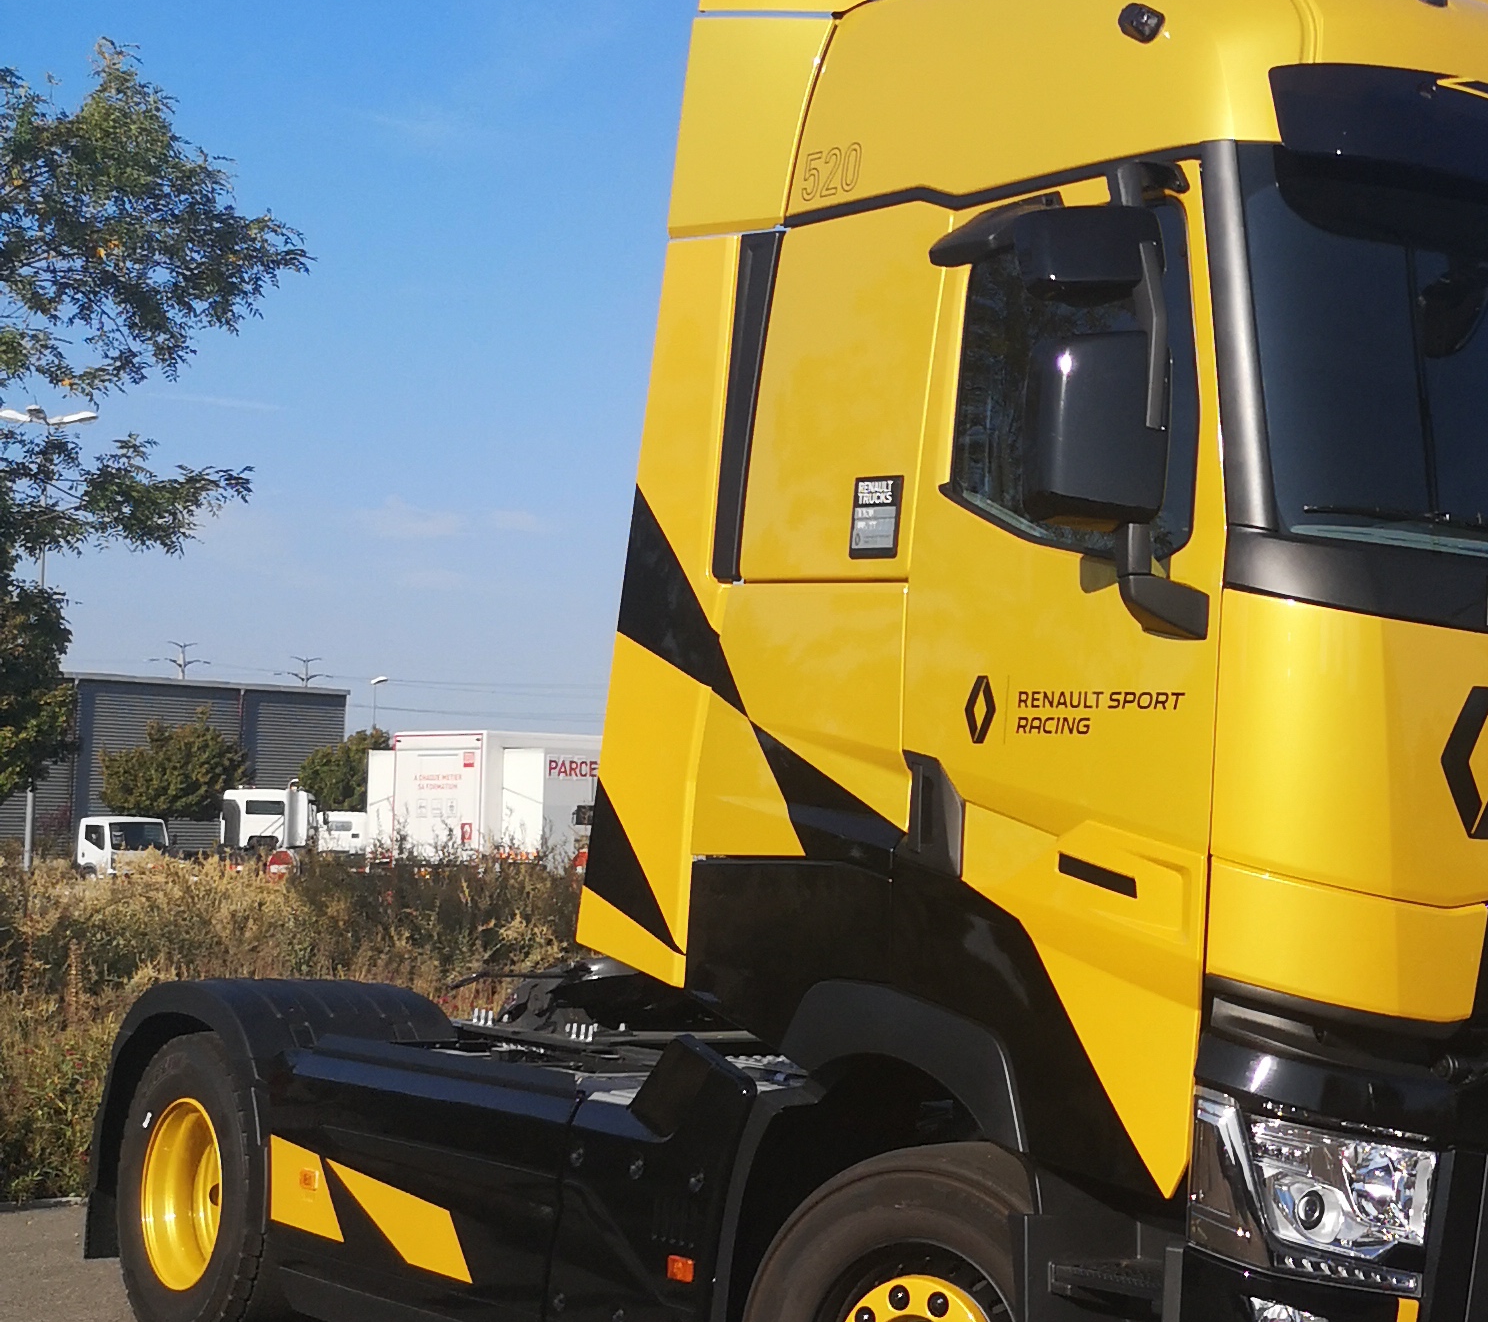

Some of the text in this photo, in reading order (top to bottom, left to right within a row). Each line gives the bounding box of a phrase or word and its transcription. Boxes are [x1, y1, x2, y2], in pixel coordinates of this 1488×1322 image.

[802, 142, 862, 201] 520
[858, 480, 894, 493] RENAULT
[857, 492, 893, 505] TRUCKS
[1017, 691, 1186, 710] RENAULT SPORT
[1015, 716, 1091, 735] RACING
